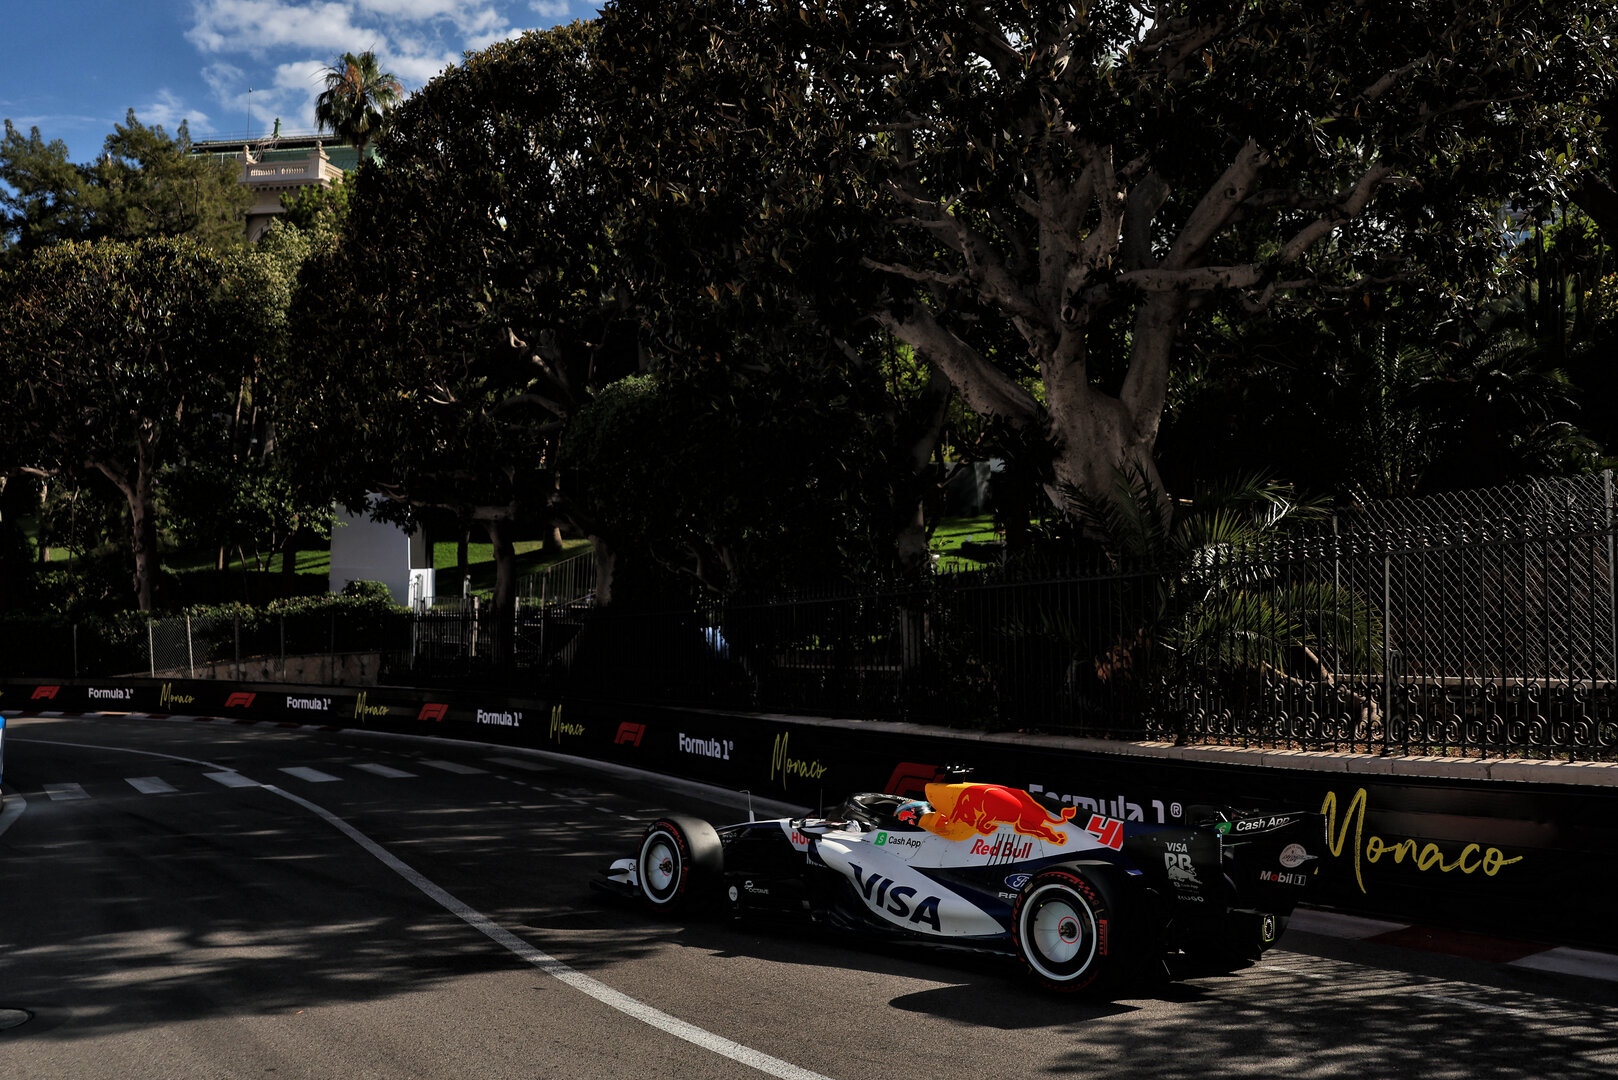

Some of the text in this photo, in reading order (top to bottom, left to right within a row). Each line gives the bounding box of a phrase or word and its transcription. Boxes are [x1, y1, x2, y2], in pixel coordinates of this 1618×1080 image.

[88, 687, 124, 699] Formula
[159, 683, 195, 709] Monaco
[286, 696, 321, 710] Formula
[354, 691, 390, 722] Monaco
[476, 709, 513, 726] Formula
[550, 703, 586, 744] Monaco
[678, 732, 721, 758] Formula
[770, 731, 828, 790] Monaco
[1236, 816, 1290, 831] Cash App
[888, 836, 921, 848] Cash App
[970, 839, 1033, 859] Red Bull
[1164, 842, 1188, 853] VISA
[1318, 788, 1524, 894] Monaco
[1259, 871, 1293, 884] Mobil
[849, 862, 941, 932] VISA
